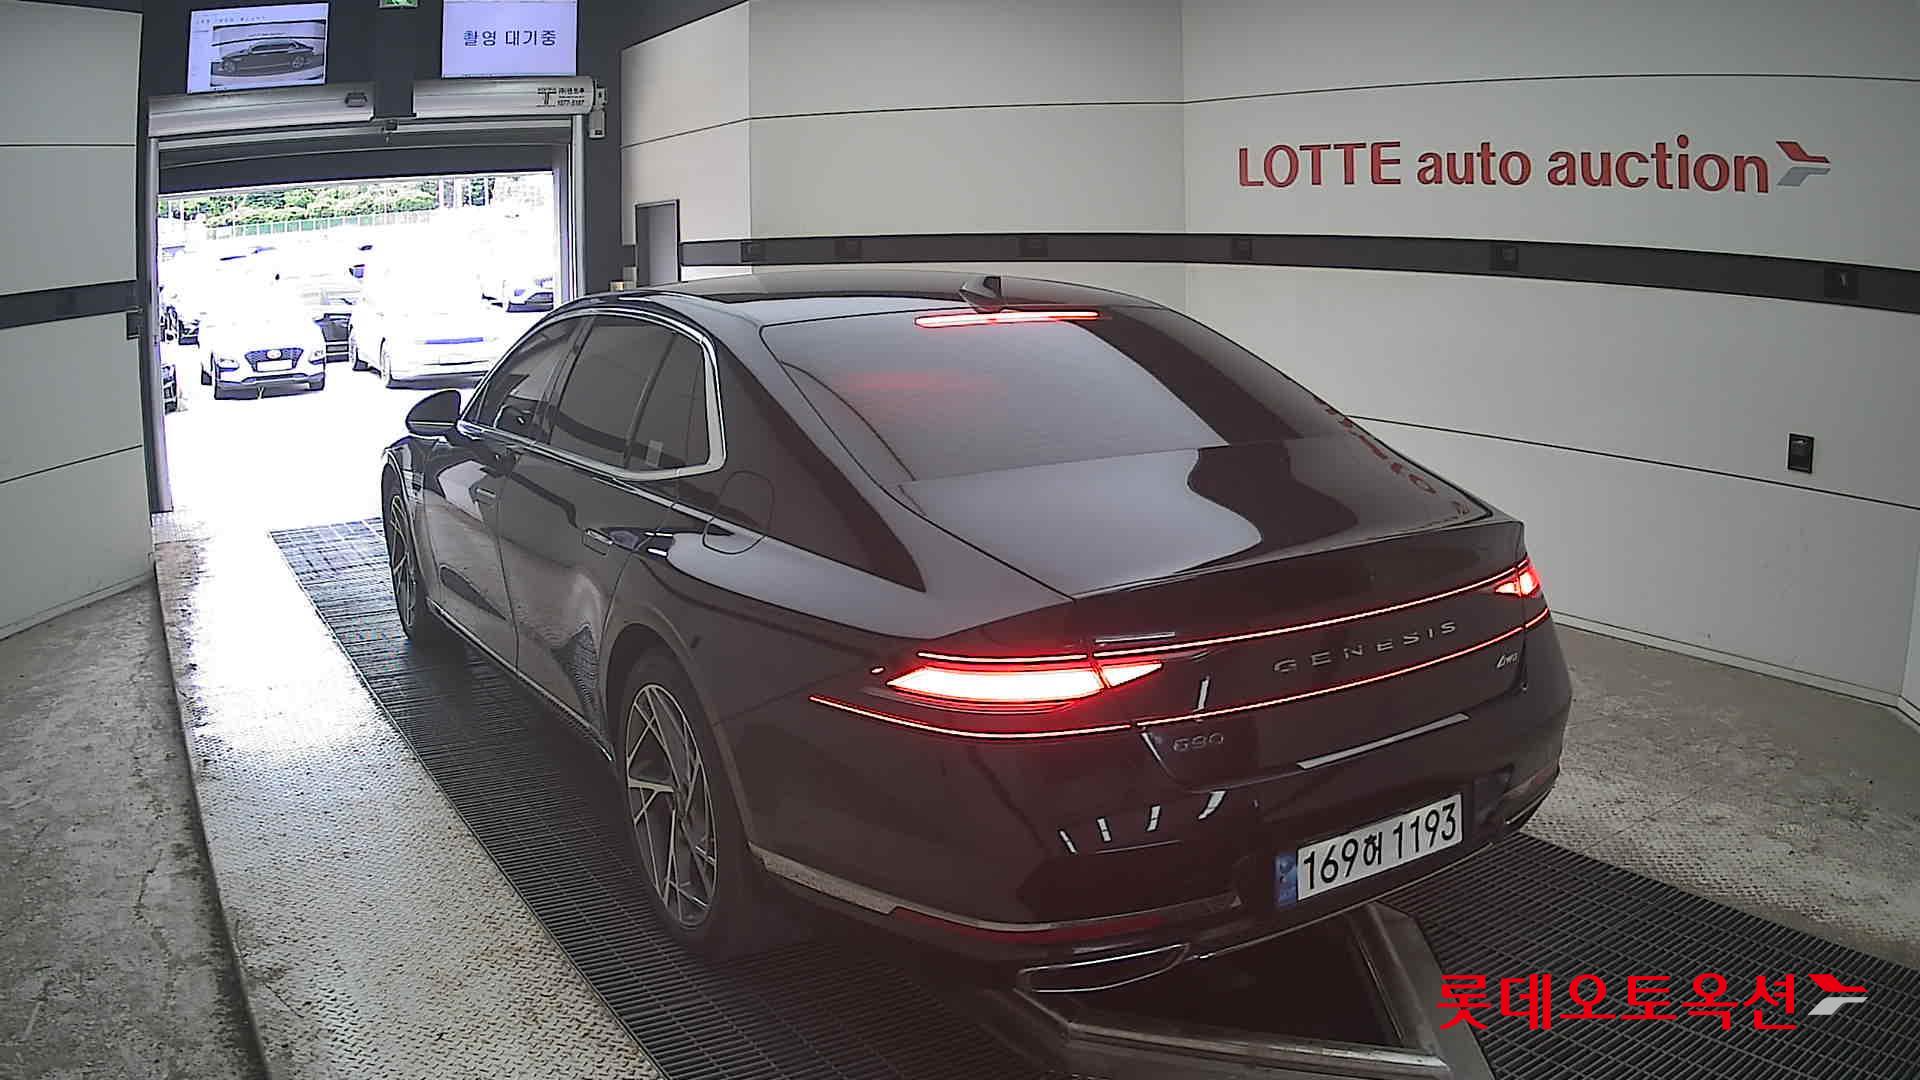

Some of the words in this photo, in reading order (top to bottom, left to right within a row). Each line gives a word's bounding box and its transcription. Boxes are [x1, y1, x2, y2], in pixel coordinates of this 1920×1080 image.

[463, 30, 496, 47] 촬영
[505, 30, 557, 46] 대기중
[1239, 141, 1400, 188] LOTTE
[1416, 142, 1532, 186] auto
[1547, 134, 1769, 194] auction
[1273, 620, 1457, 673] GENESIS
[1303, 831, 1384, 890] 169허
[1393, 802, 1457, 860] 1193
